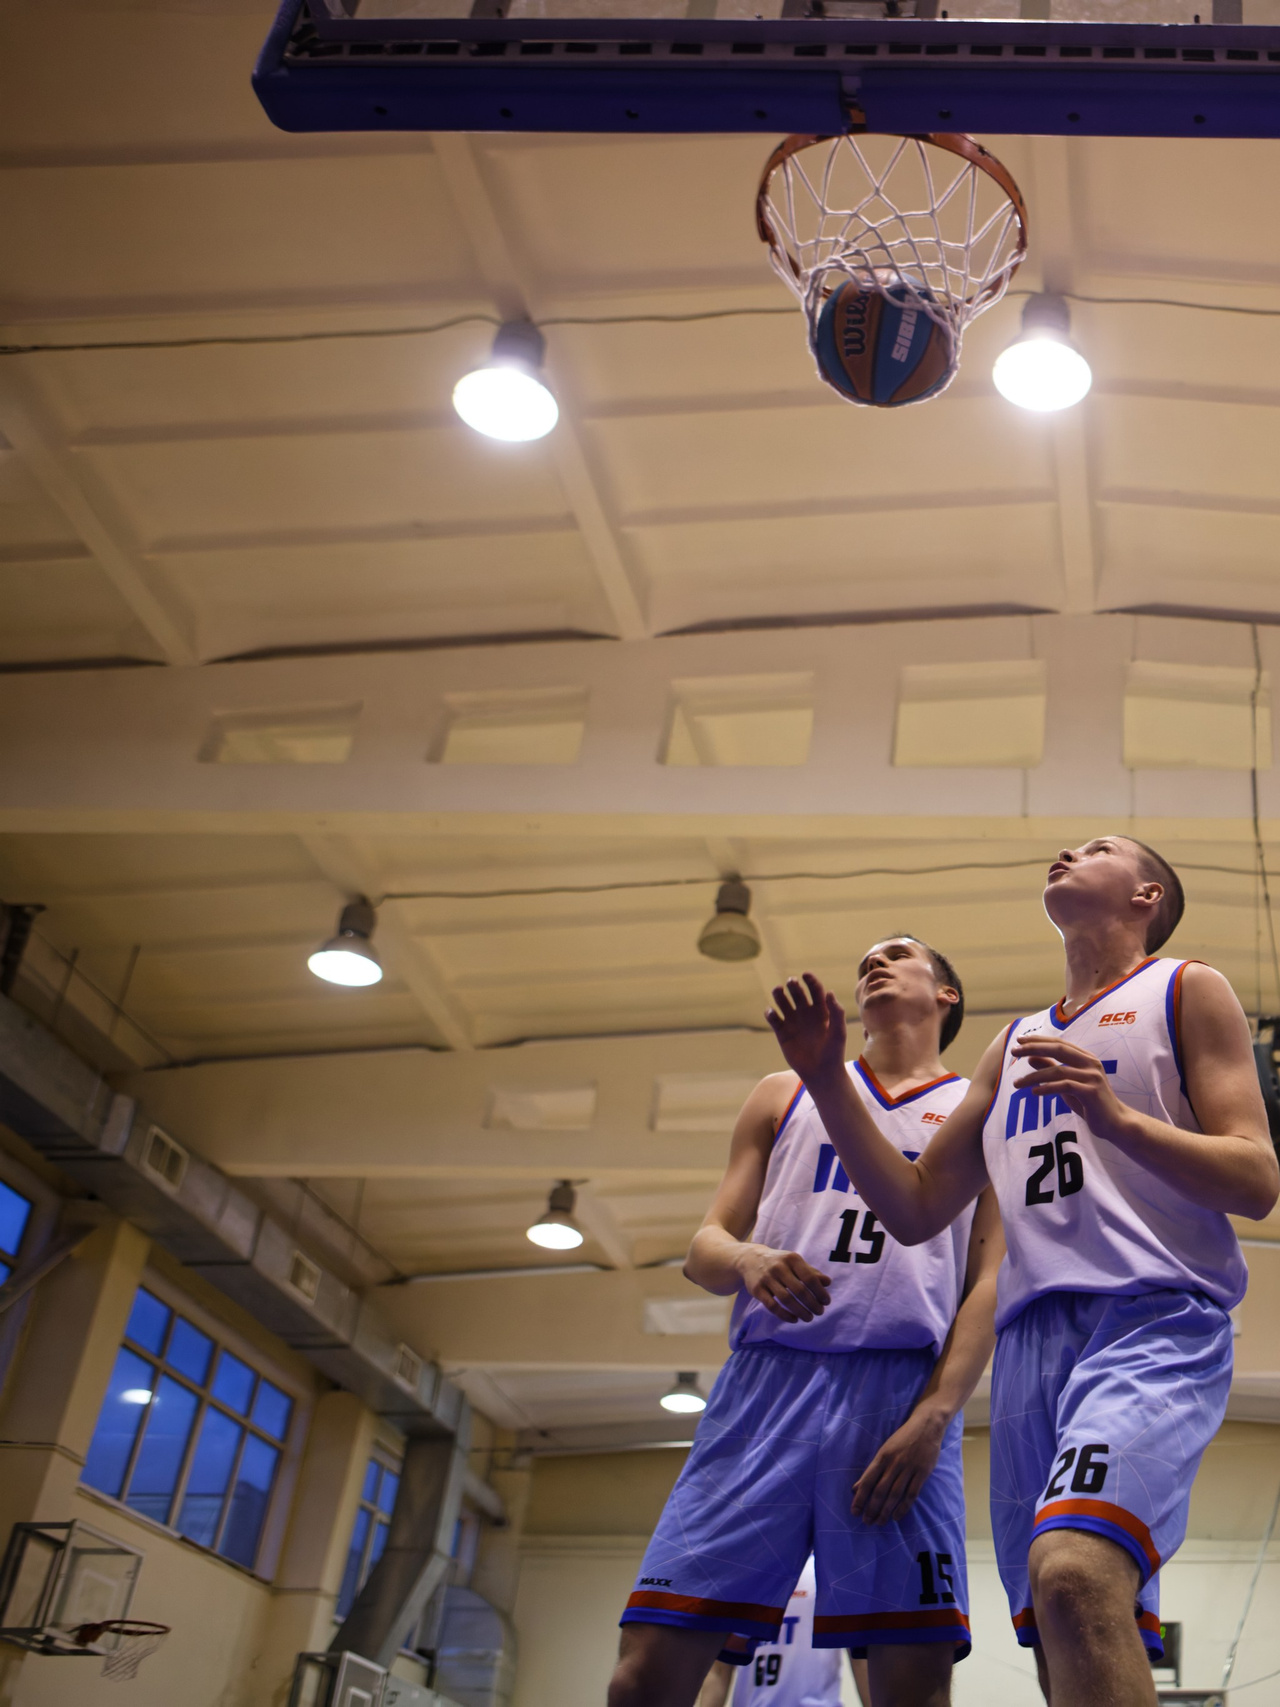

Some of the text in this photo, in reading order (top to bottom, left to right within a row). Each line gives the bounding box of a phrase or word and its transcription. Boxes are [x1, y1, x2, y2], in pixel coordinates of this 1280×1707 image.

[843, 288, 870, 358] Wils
[1025, 1131, 1084, 1206] 26
[829, 1209, 886, 1264] 15
[1044, 1444, 1109, 1502] 26
[917, 1551, 956, 1605] 15
[755, 1654, 782, 1686] 69
